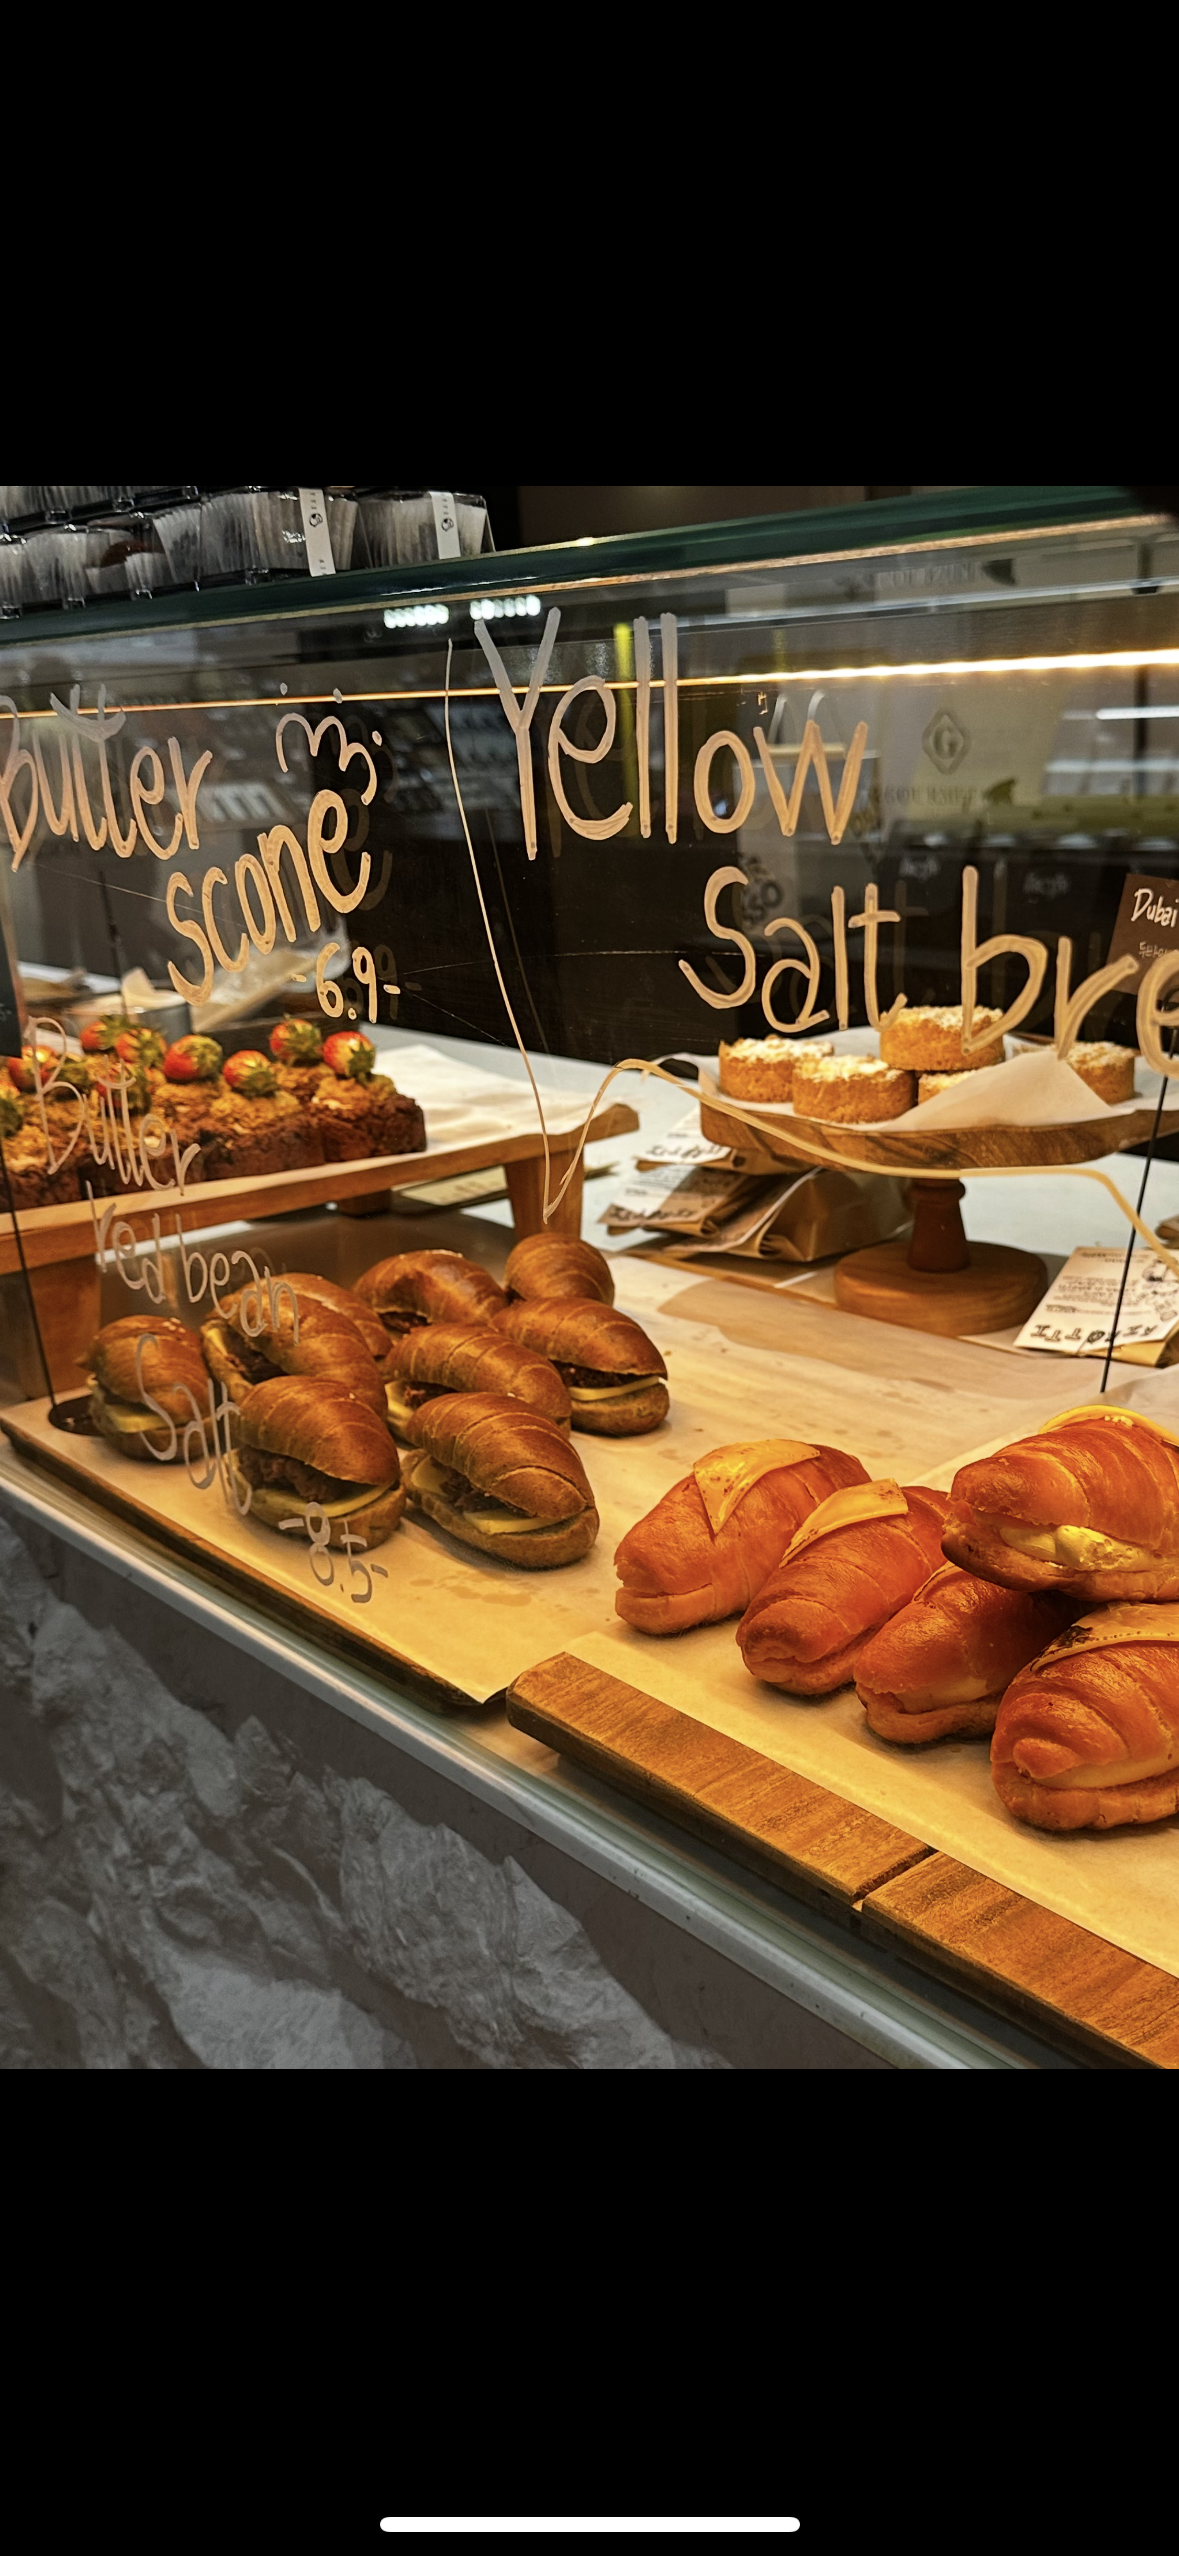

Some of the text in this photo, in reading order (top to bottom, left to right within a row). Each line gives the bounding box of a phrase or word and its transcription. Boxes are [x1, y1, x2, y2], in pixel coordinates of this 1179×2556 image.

[0, 683, 213, 873] Butter
[474, 606, 869, 861] Yellow
[167, 789, 371, 1006] scone
[678, 865, 908, 1034] Salt
[1131, 888, 1179, 928] Dubai
[25, 1016, 201, 1197] Butter
[85, 1180, 300, 1346] red bean
[135, 1332, 253, 1516] Salt
